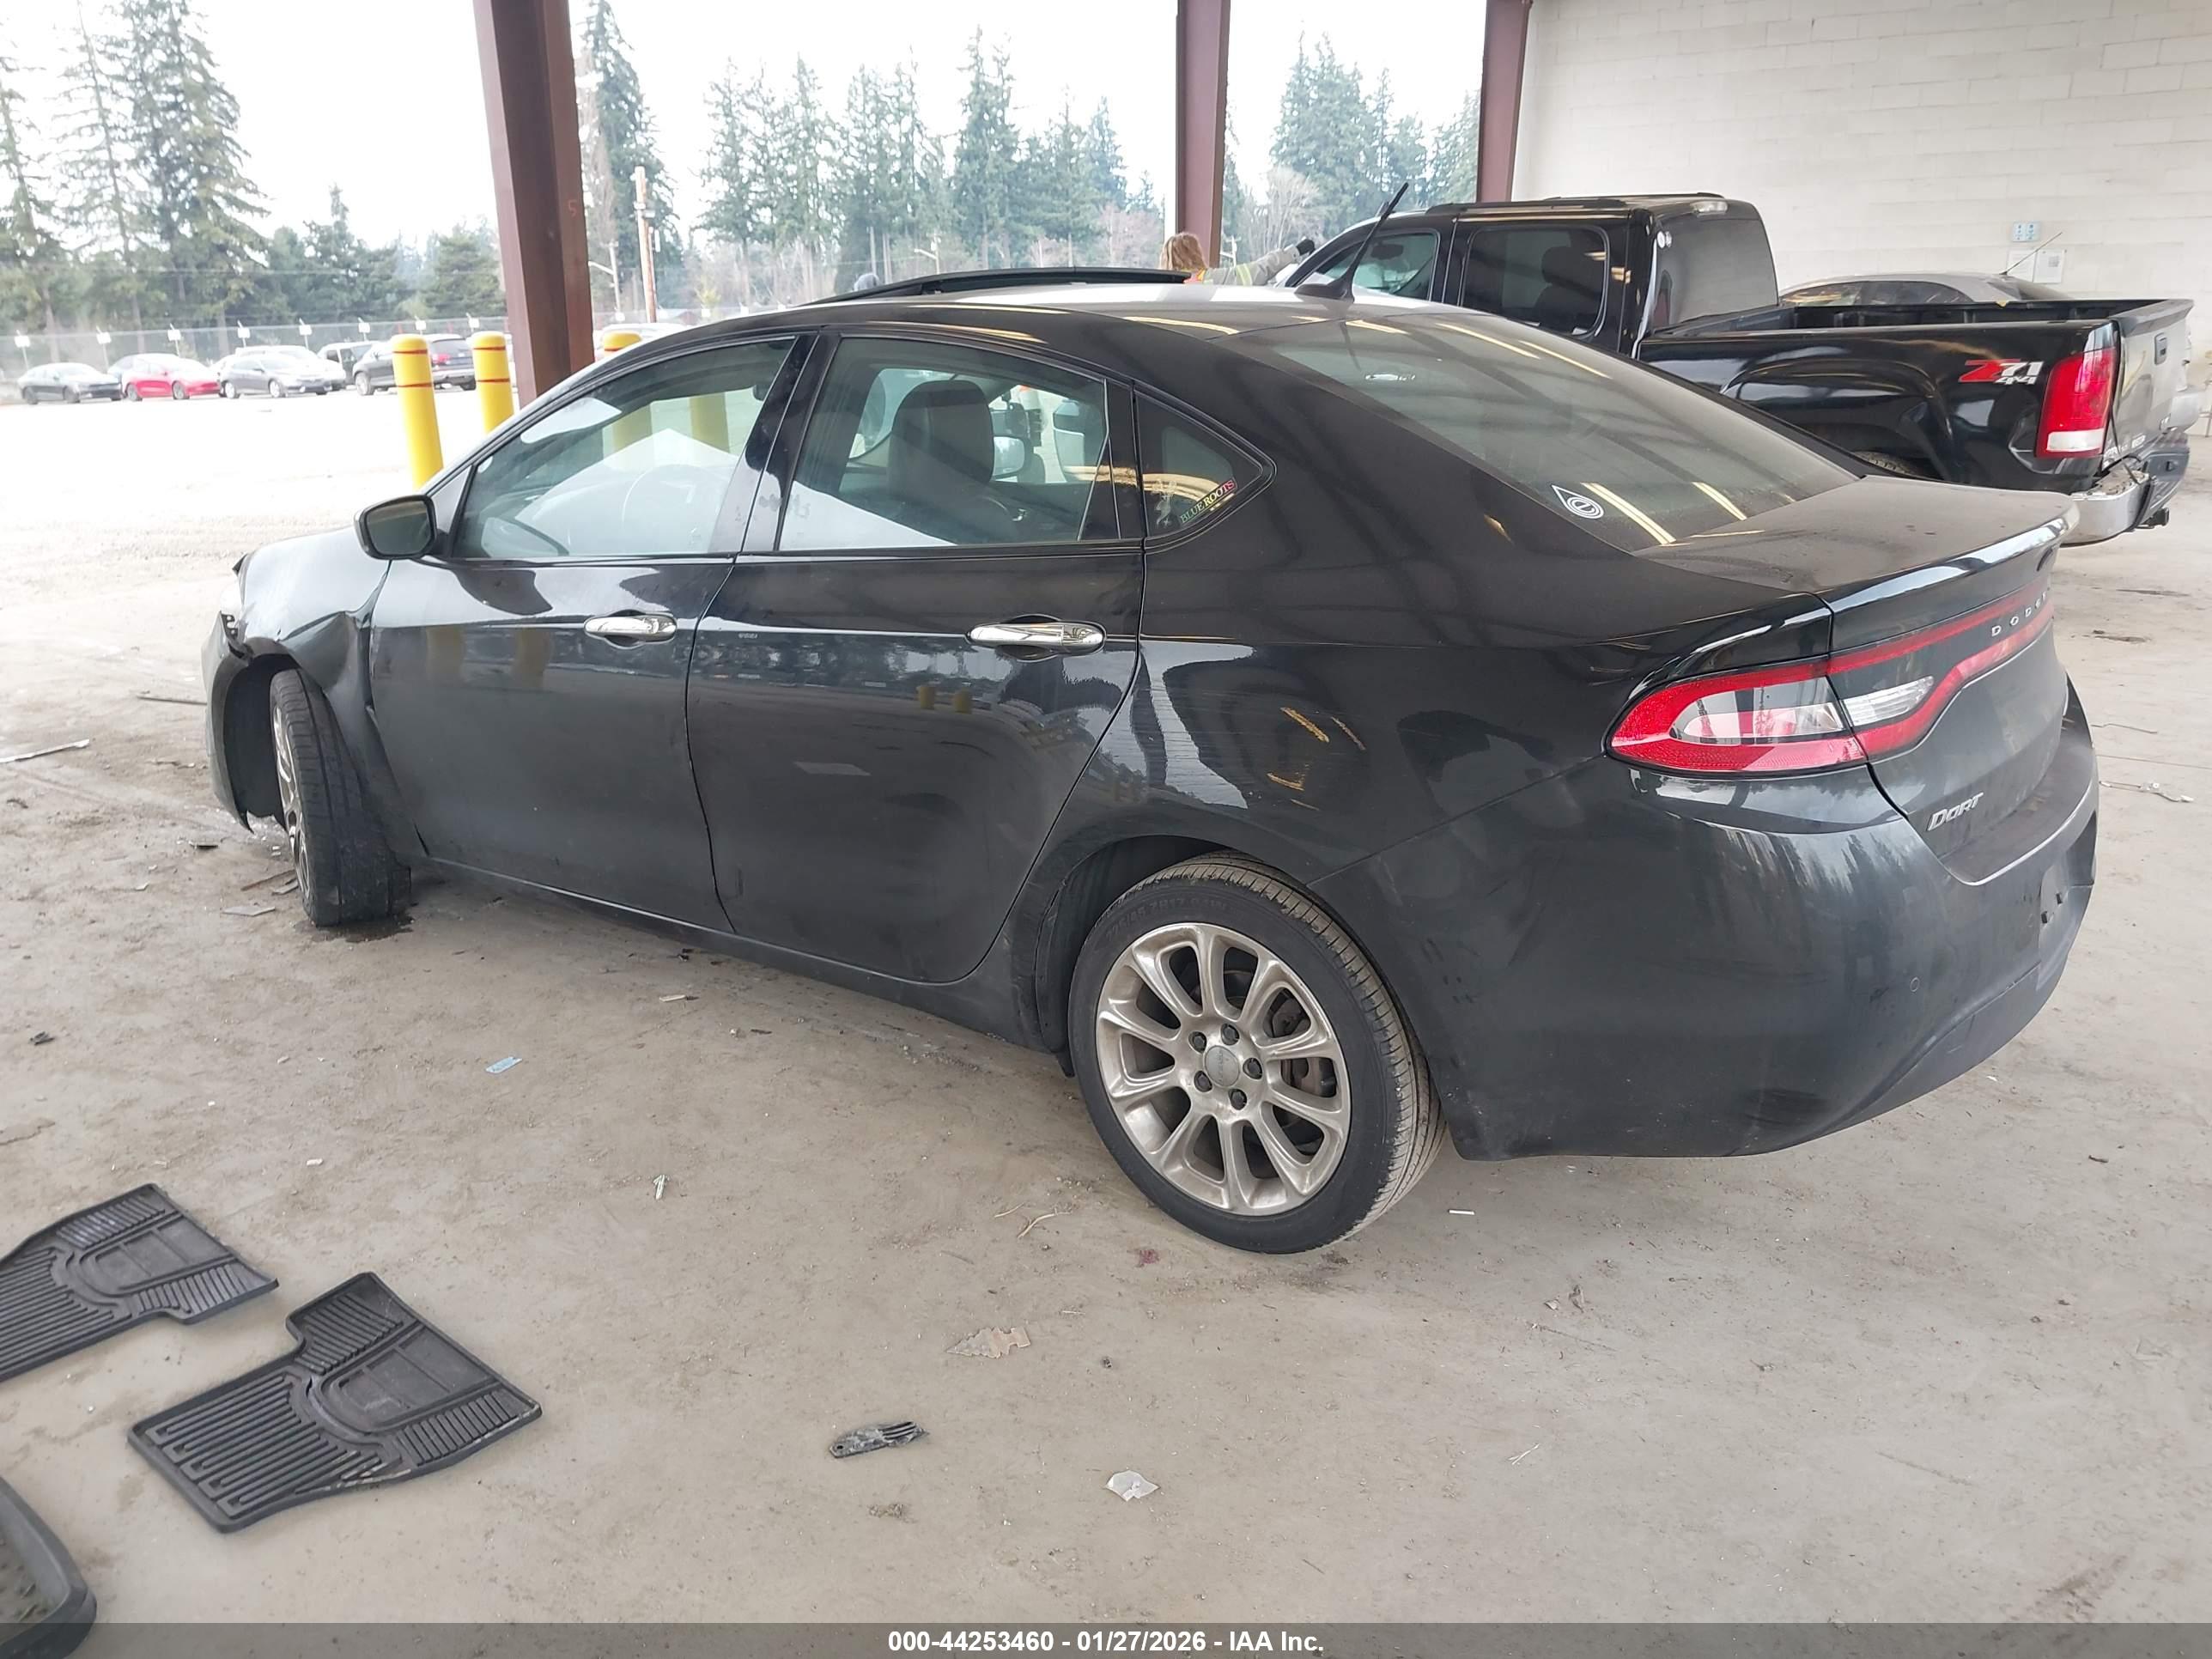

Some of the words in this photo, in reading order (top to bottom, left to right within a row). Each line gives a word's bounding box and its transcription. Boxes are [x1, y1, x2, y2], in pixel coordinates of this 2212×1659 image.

[1959, 358, 2045, 383] Z71
[1180, 504, 1206, 524] BLUE
[1203, 479, 1235, 507] ROOTS
